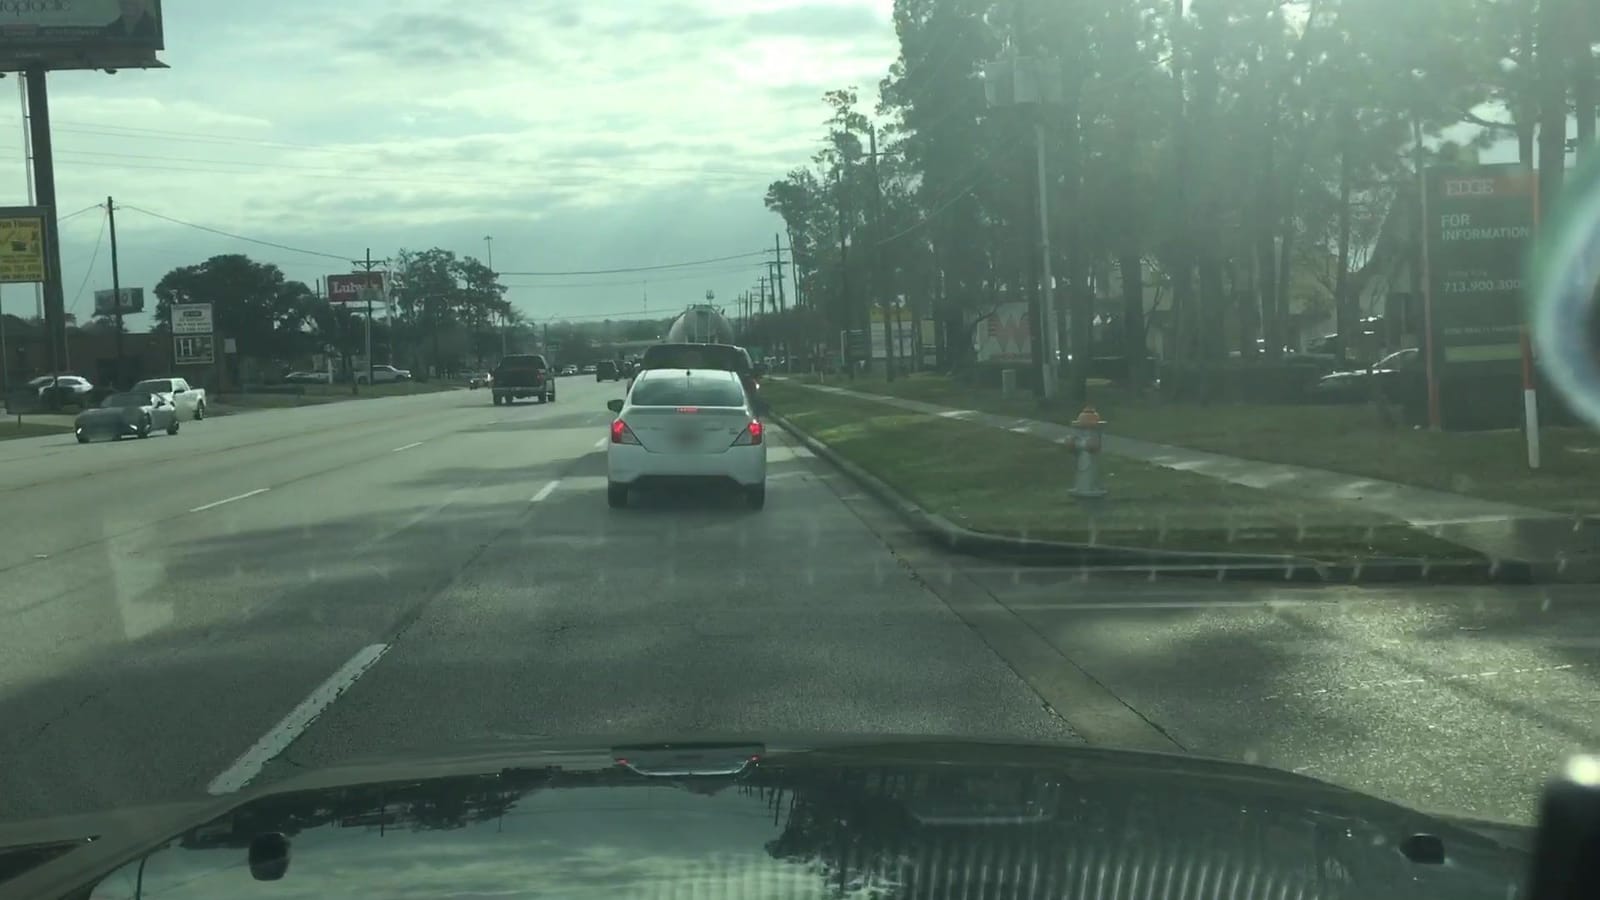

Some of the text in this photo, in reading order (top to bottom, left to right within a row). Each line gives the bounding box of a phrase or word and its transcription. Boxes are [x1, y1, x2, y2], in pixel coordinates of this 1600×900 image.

[1445, 177, 1495, 196] EDGE
[1441, 213, 1471, 228] FOR
[1441, 226, 1530, 241] INFORMATION
